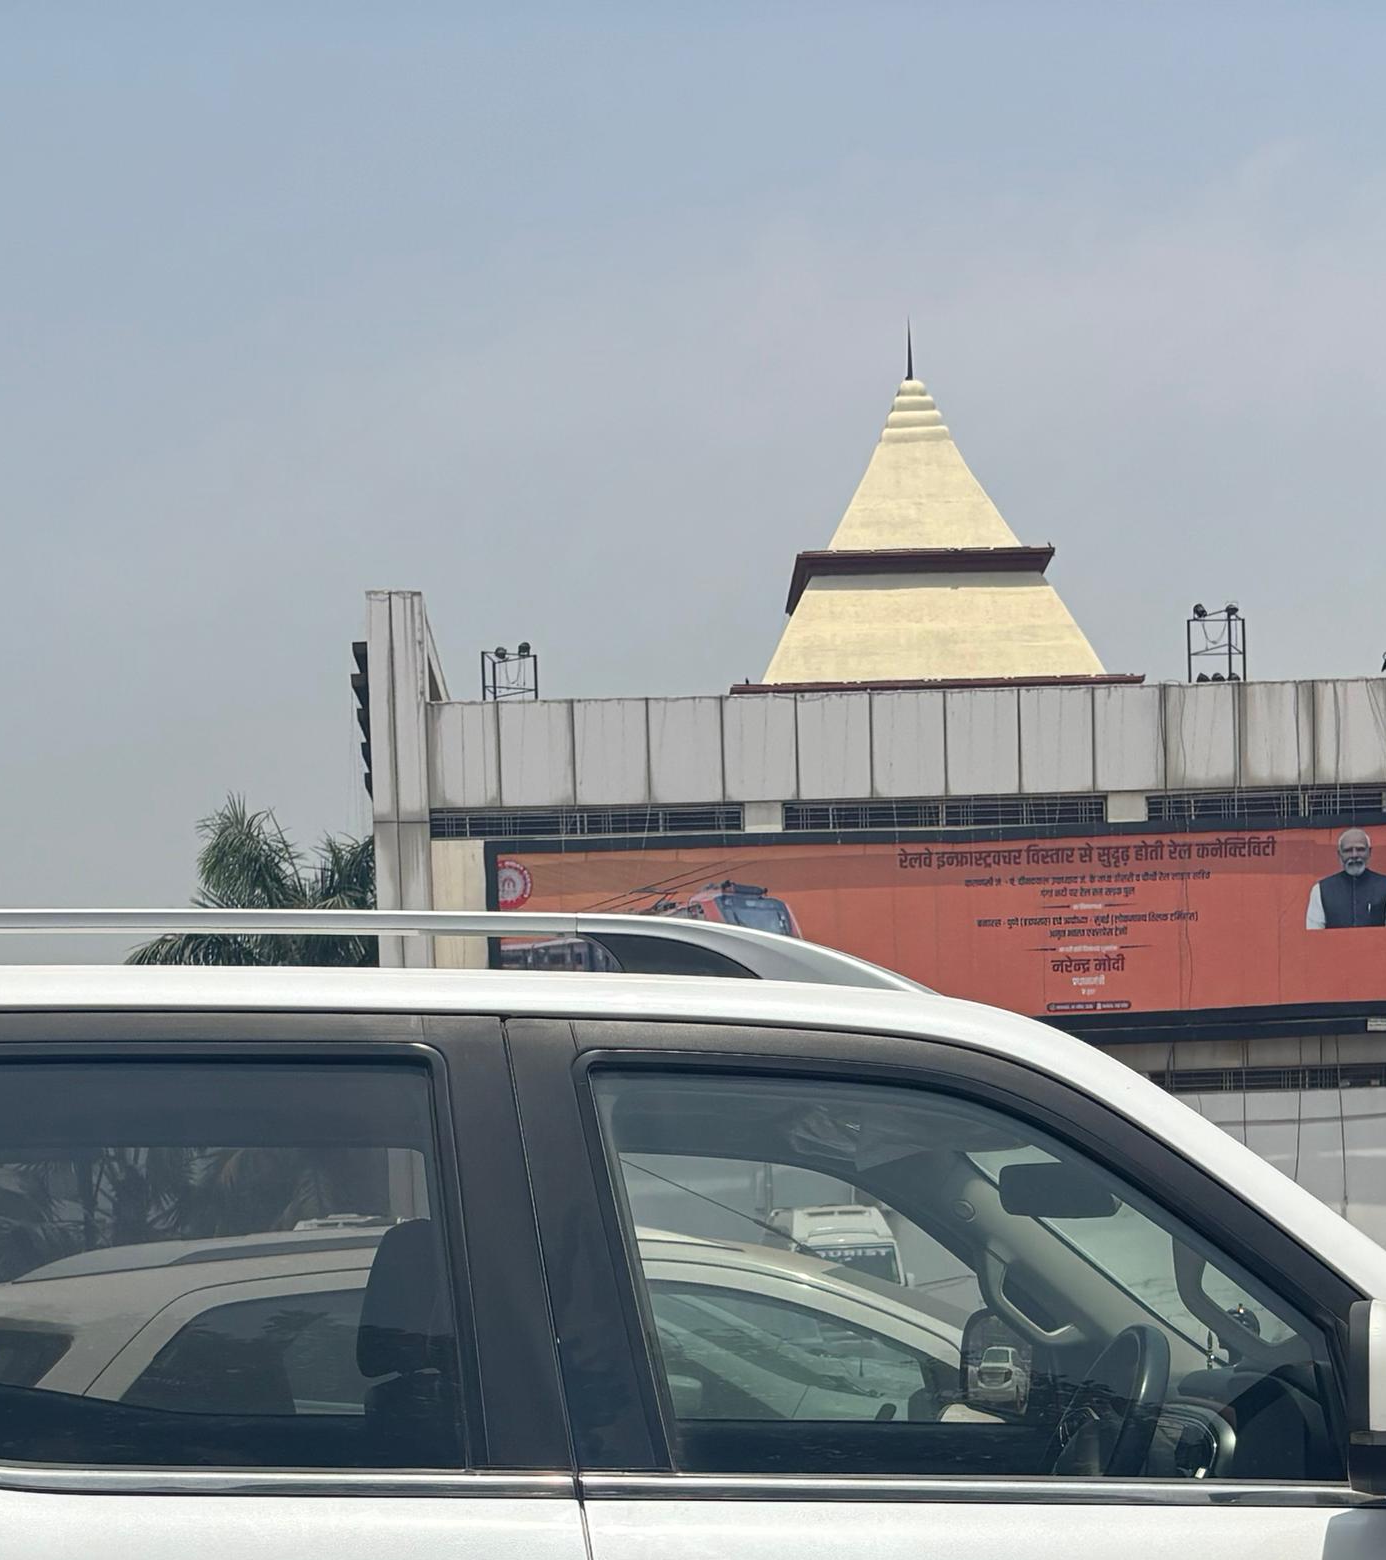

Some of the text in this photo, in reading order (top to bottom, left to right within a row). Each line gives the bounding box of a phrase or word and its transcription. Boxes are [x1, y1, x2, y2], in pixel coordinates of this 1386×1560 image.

[897, 846, 934, 869] रेलवे
[1024, 843, 1074, 865] विस्तार
[1077, 841, 1094, 863] से
[1132, 839, 1164, 861] होती
[1166, 839, 1193, 860] रेल
[1194, 835, 1277, 859] कनेक्टिविटी
[1050, 952, 1125, 973] नरेन्द्र मोदी
